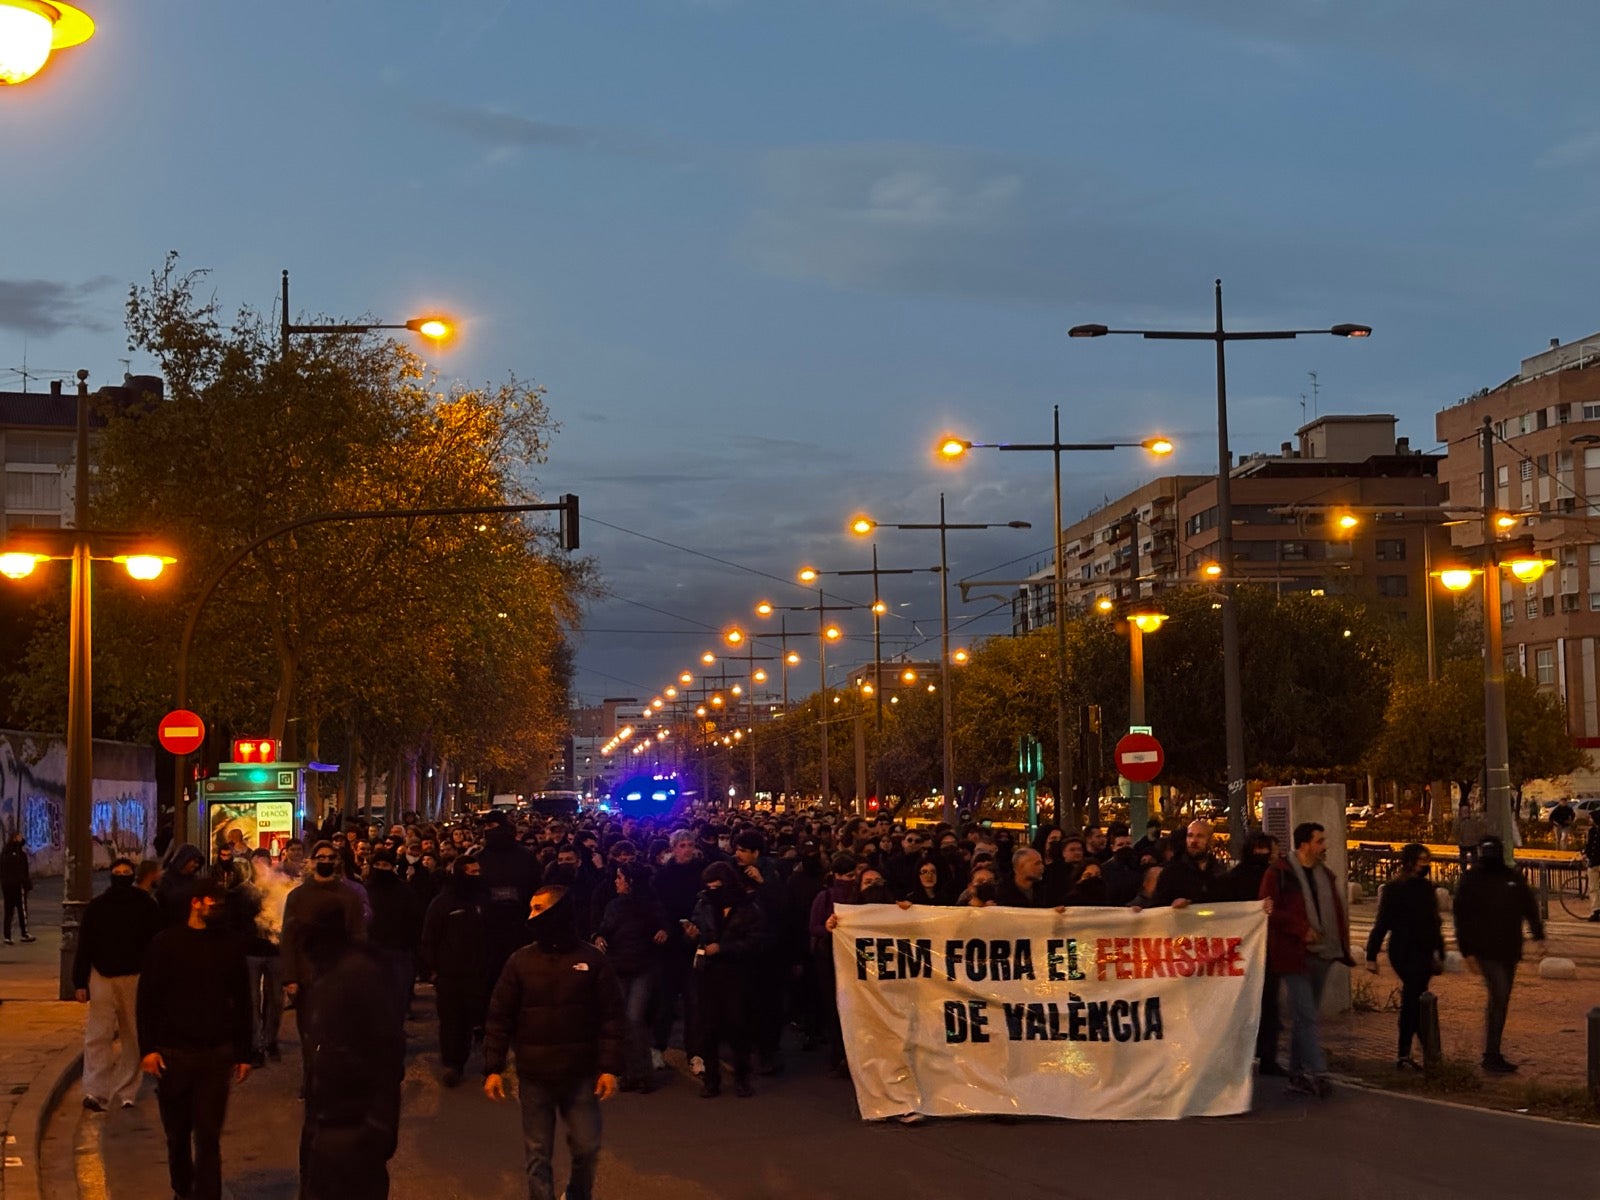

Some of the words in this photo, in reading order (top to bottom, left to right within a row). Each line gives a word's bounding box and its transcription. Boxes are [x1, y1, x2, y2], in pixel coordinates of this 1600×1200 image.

[856, 938, 932, 981] FEM
[945, 938, 1036, 982] FORA
[1047, 938, 1085, 981] EL
[1097, 938, 1245, 979] FEIXISME
[944, 1001, 990, 1043] DE
[1004, 992, 1164, 1043] VALÈNCIA
